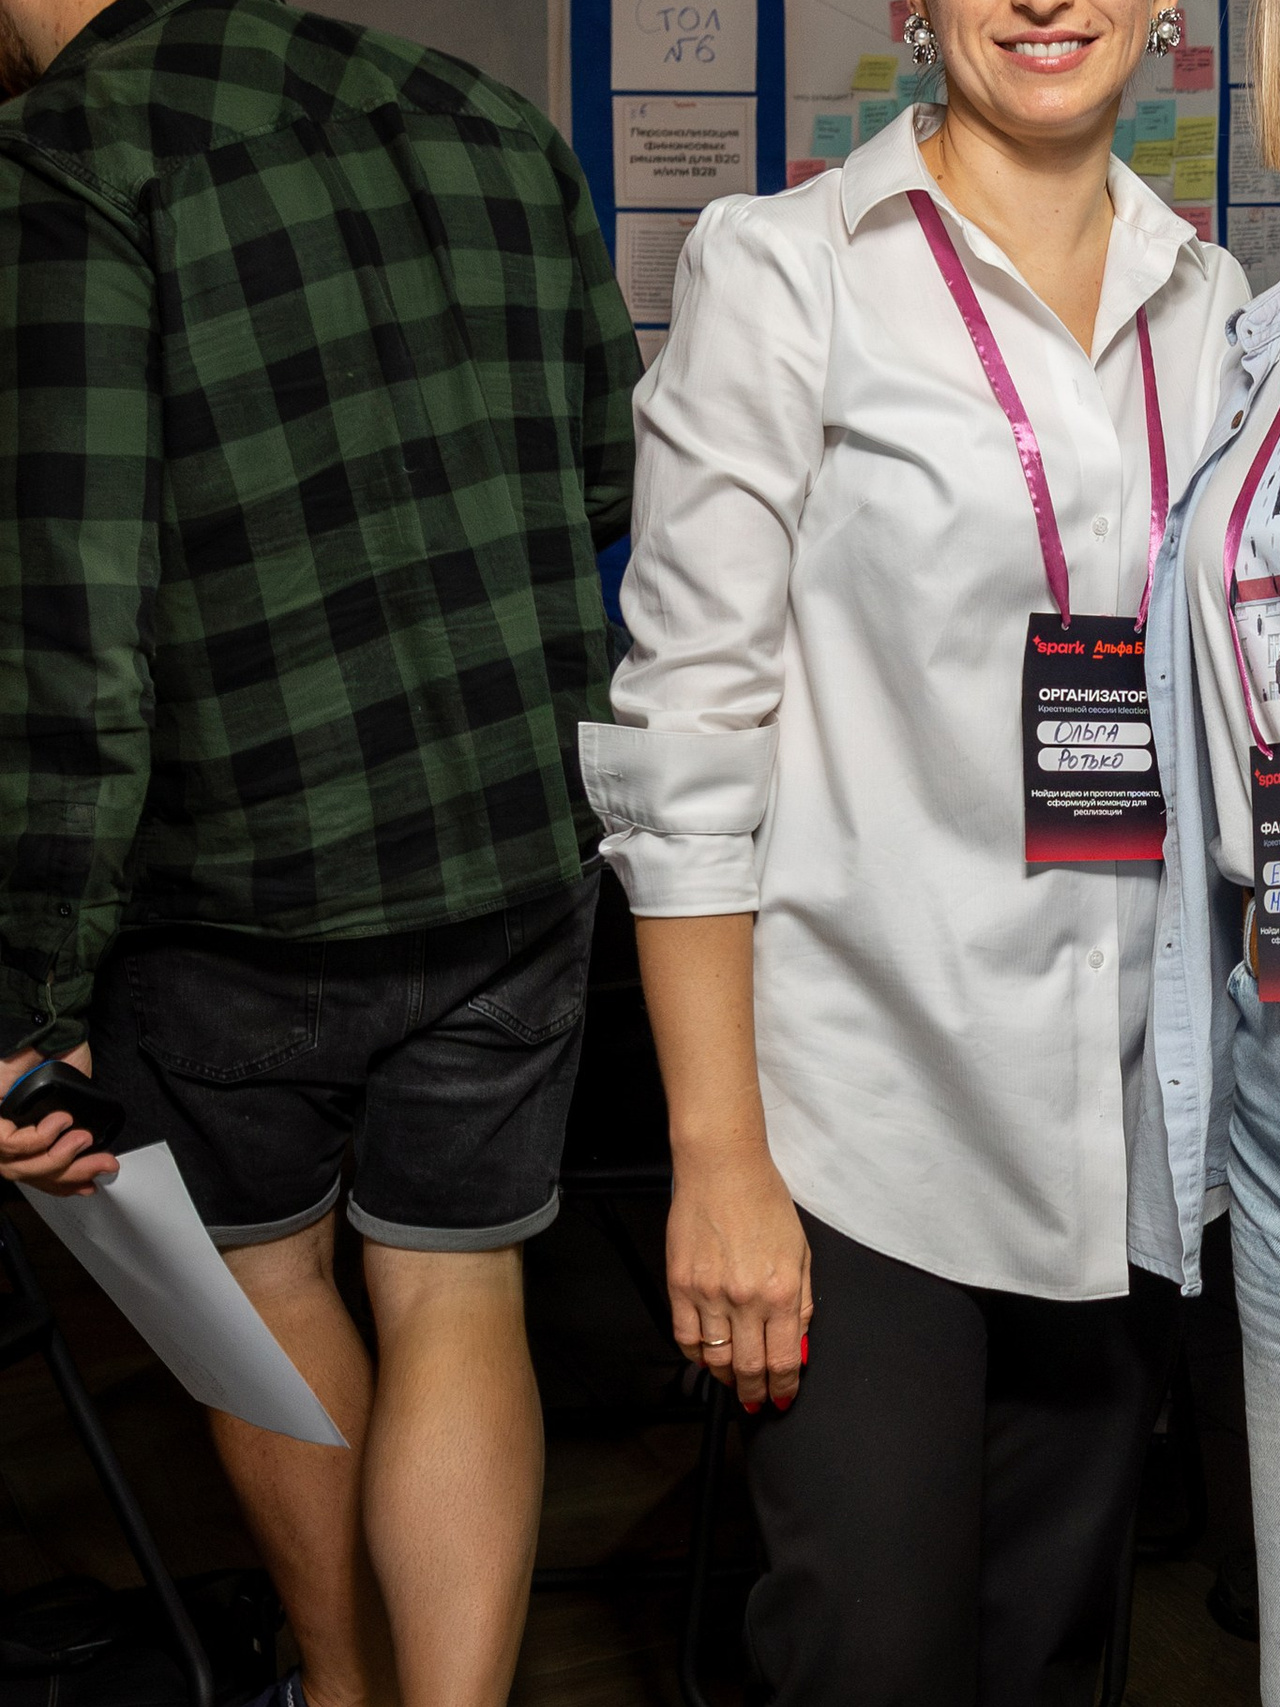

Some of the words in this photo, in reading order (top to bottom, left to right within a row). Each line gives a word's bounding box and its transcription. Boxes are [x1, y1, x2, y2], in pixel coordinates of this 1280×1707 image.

[635, 0, 721, 34] СТОЛ
[630, 127, 739, 138] Персонализация
[630, 153, 686, 164] решений
[688, 155, 712, 164] для
[1037, 640, 1085, 656] spark
[1092, 640, 1132, 658] Альфа
[1135, 642, 1145, 655] Б
[1038, 688, 1148, 703] ОРГАНИЗАТОР
[1038, 704, 1087, 714] Креативной
[1117, 706, 1149, 715] Ideation
[1031, 789, 1060, 799] Найди
[1060, 791, 1083, 799] идею
[1090, 791, 1126, 799] прототип
[1127, 791, 1161, 799] проекта,
[1047, 799, 1096, 808] сформируй
[1097, 800, 1131, 808] команду
[1073, 809, 1123, 817] реализации
[1260, 926, 1280, 935] Найди
